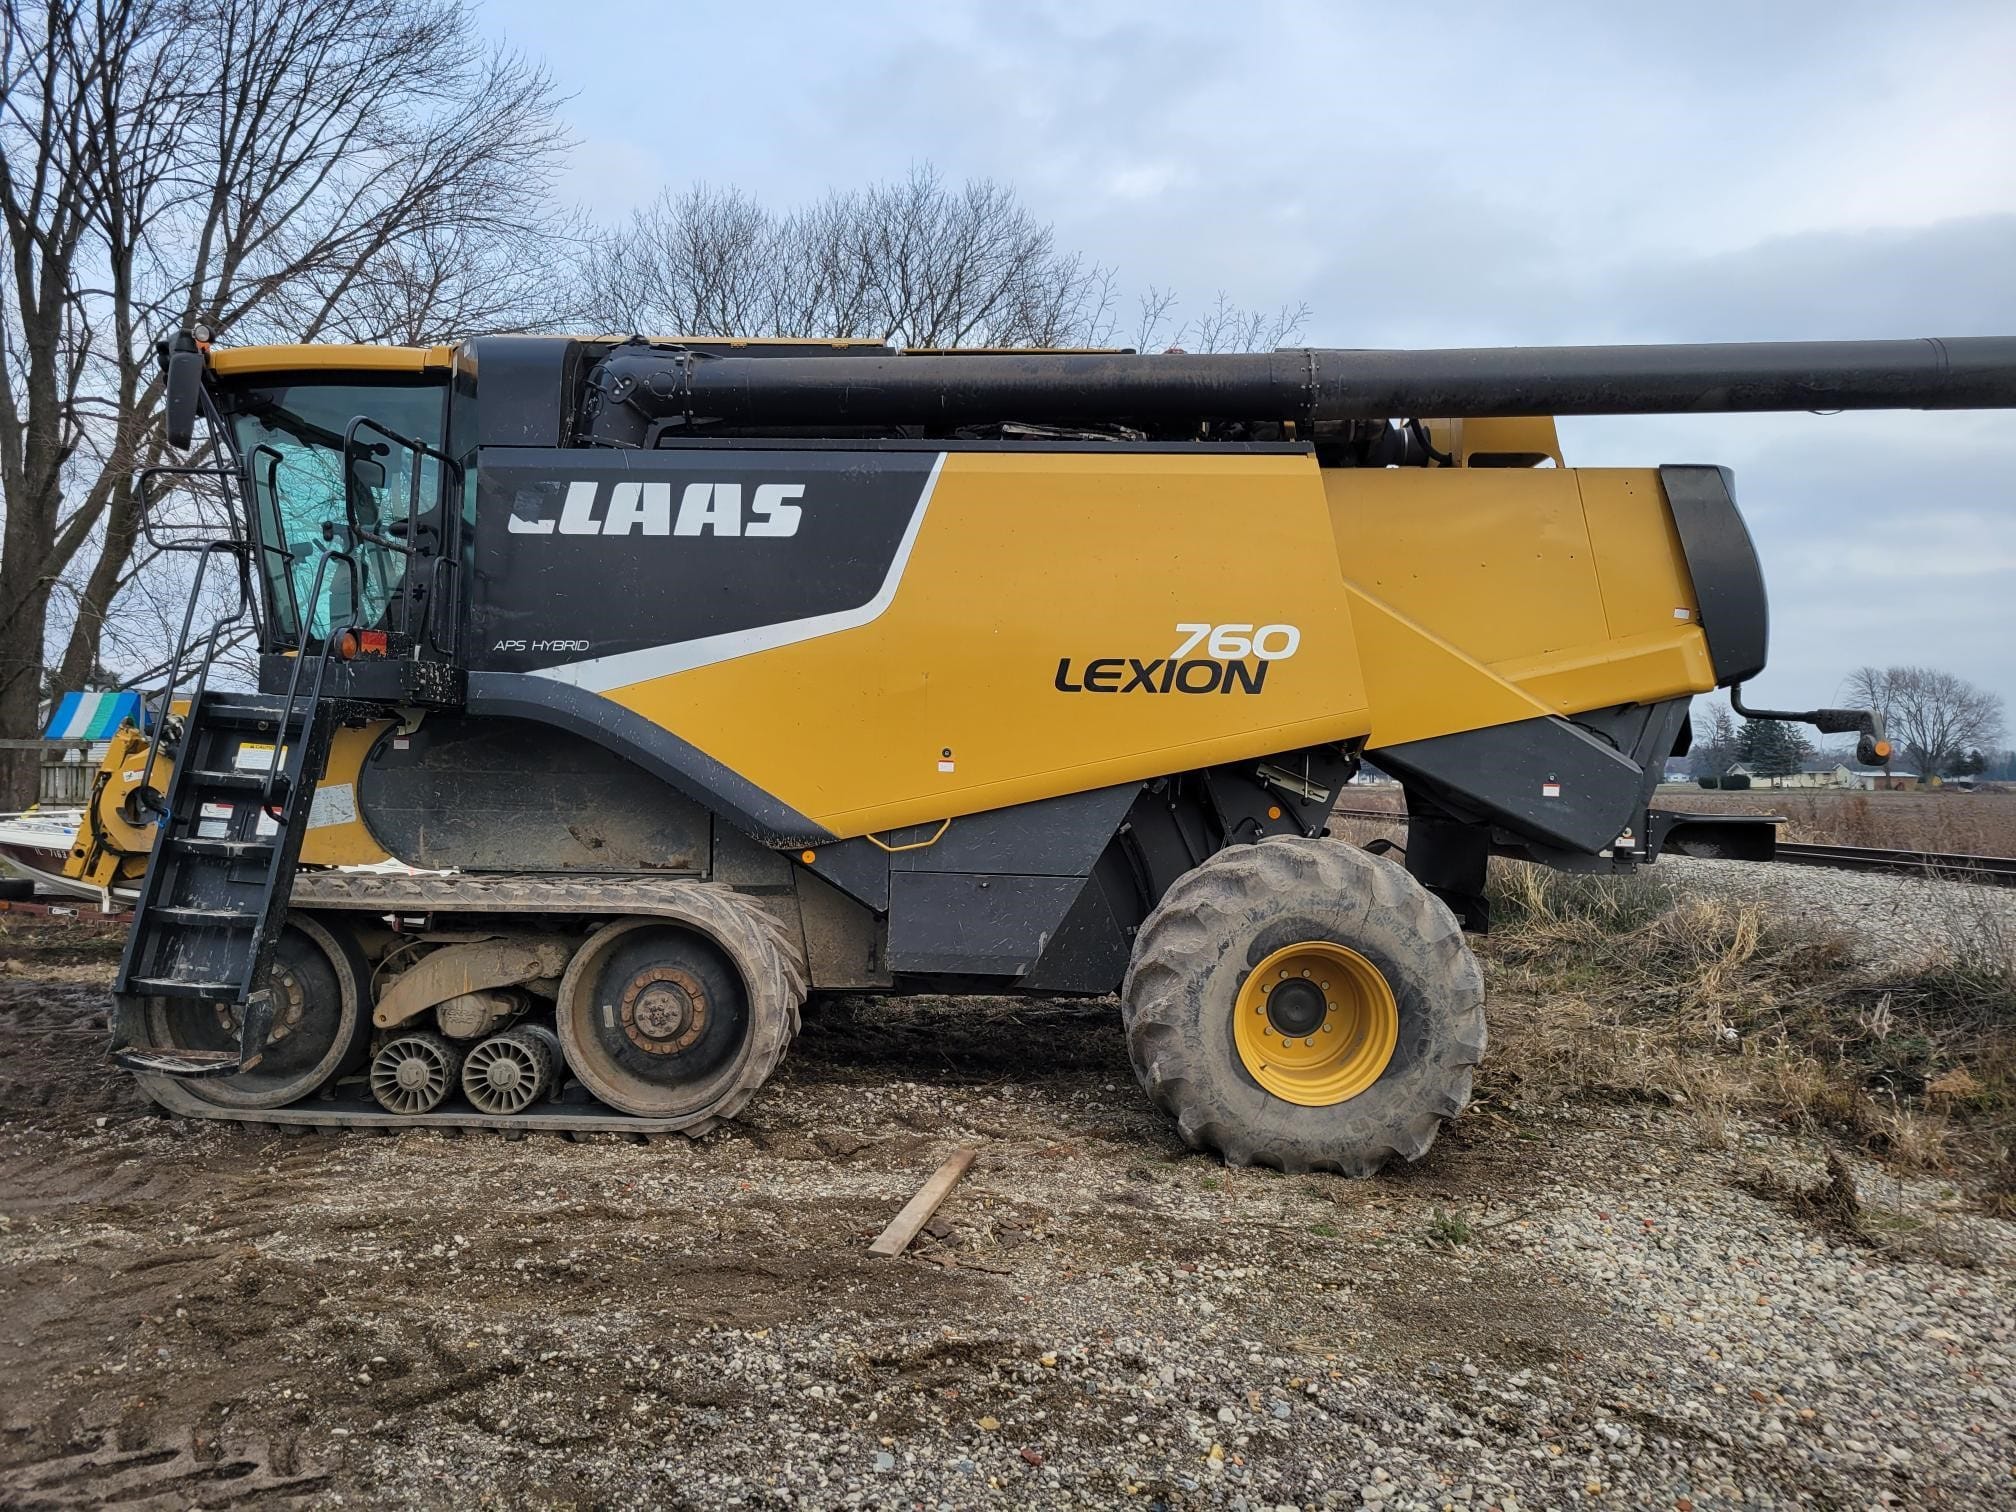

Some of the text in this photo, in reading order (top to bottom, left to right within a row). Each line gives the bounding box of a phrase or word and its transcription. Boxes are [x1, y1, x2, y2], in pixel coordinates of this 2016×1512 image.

[493, 640, 590, 652] APS HYBRID
[1170, 623, 1301, 660] 760
[1054, 657, 1269, 695] LEXION
